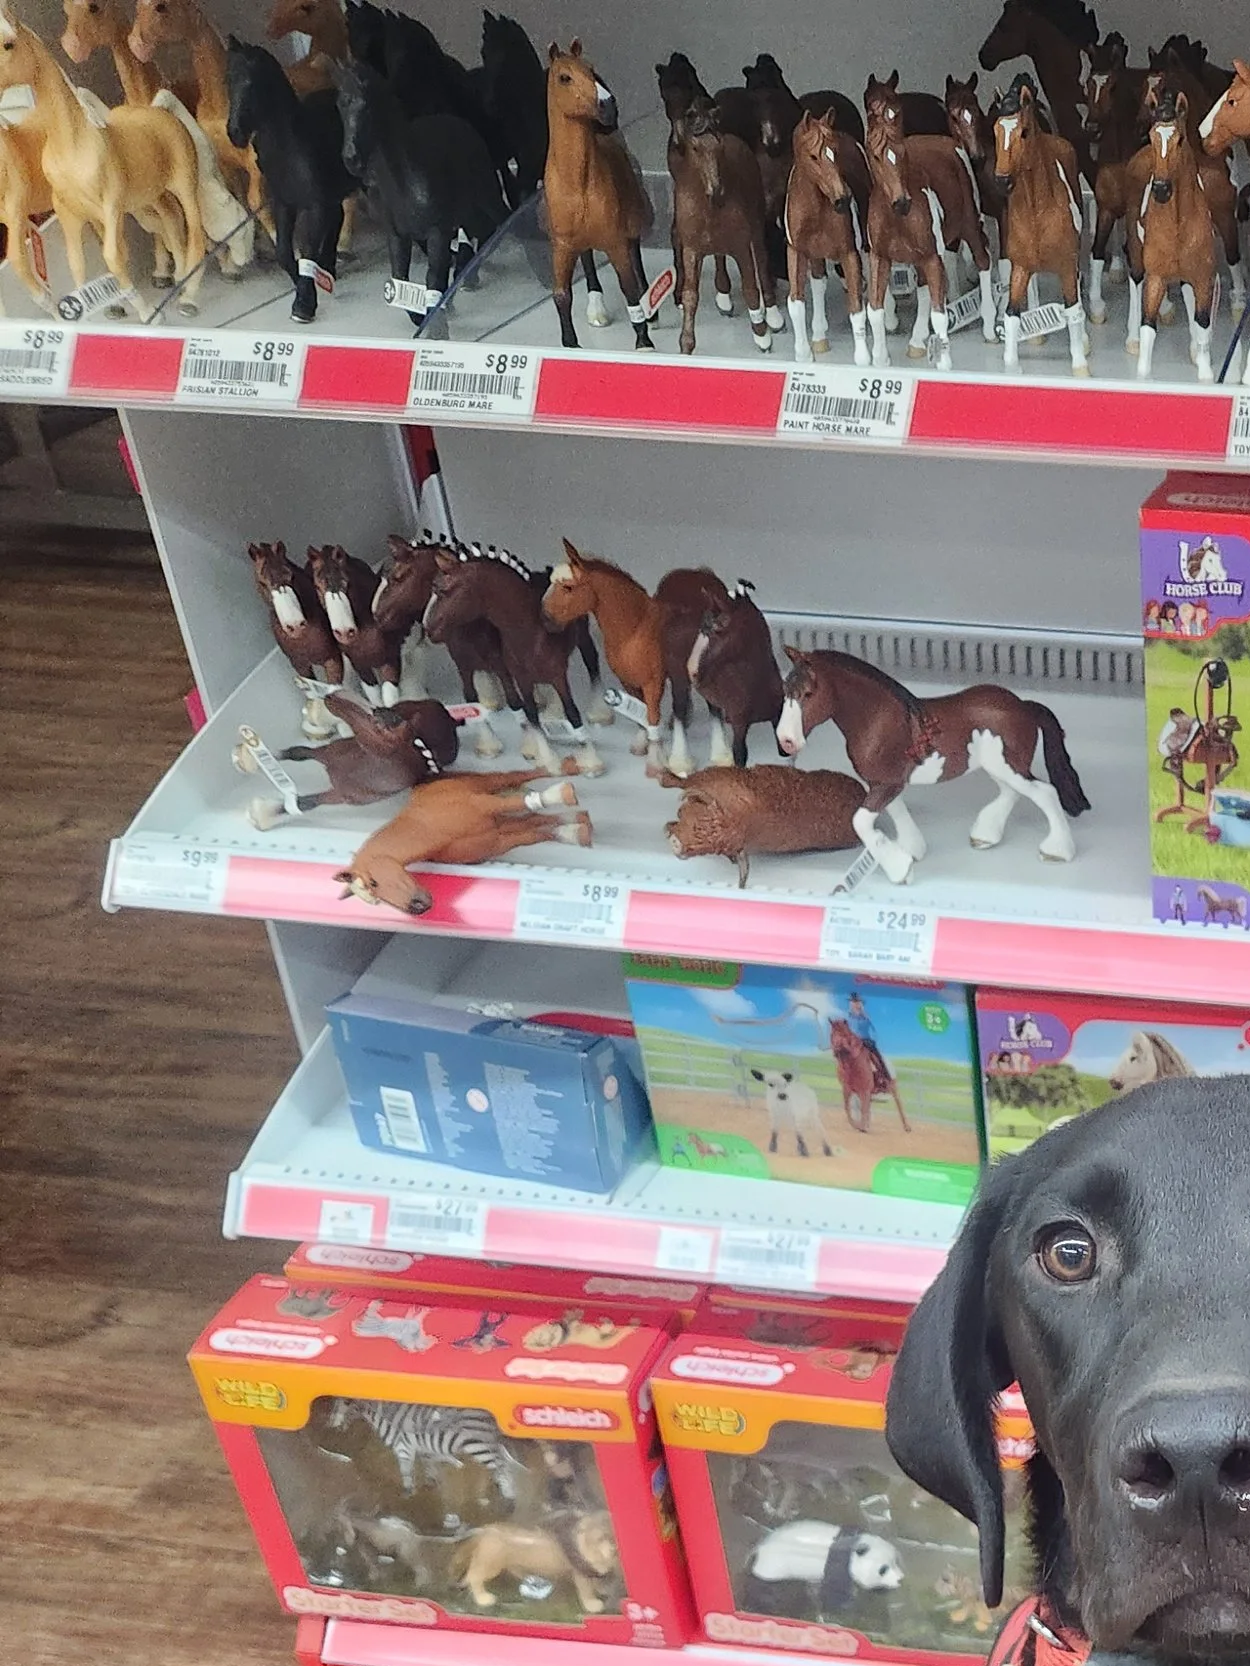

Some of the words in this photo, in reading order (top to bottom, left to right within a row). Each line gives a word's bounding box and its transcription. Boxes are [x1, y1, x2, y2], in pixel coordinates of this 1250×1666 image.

[182, 385, 216, 394] FRISIAN
[218, 387, 259, 397] STALLION
[413, 397, 465, 409] OLDENBURG
[467, 401, 494, 410] MARE
[783, 419, 809, 430] PAINT
[812, 422, 842, 433] HORSE
[845, 425, 871, 436] MARE
[1165, 582, 1208, 597] HORSE
[1209, 581, 1243, 596] CLUB
[521, 1406, 612, 1430] schleich
[676, 1403, 738, 1421] WILD
